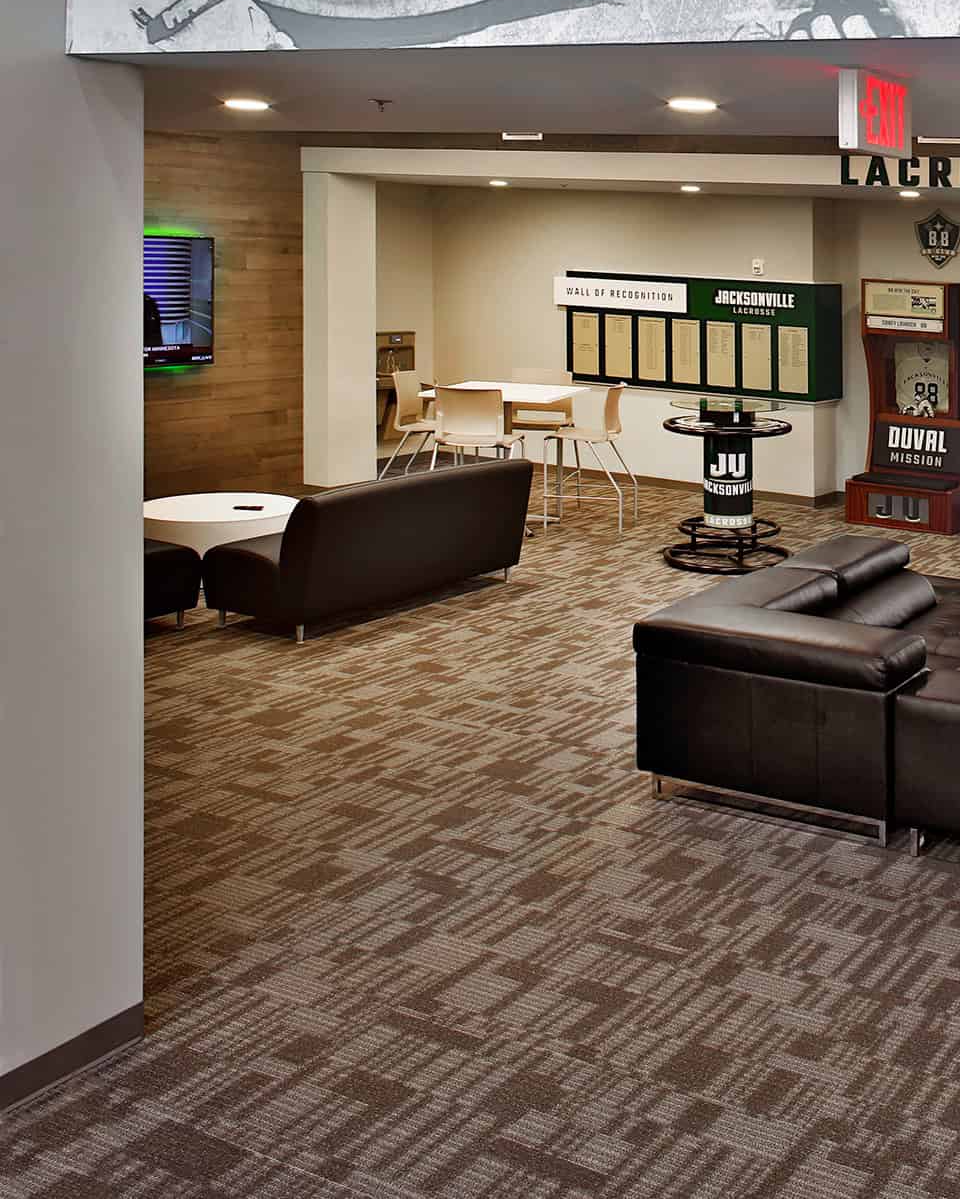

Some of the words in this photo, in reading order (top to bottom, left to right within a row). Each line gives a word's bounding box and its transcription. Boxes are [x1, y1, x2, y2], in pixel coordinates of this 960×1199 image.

[865, 75, 907, 150] EXIT
[566, 287, 591, 298] WALL
[594, 288, 606, 298] OF
[609, 289, 674, 302] RECOGNITION
[714, 289, 796, 310] JACKSONVILLE
[732, 306, 777, 317] LACROSSE
[888, 425, 948, 453] DUVAL
[709, 452, 747, 478] JU
[890, 452, 943, 467] MISSION
